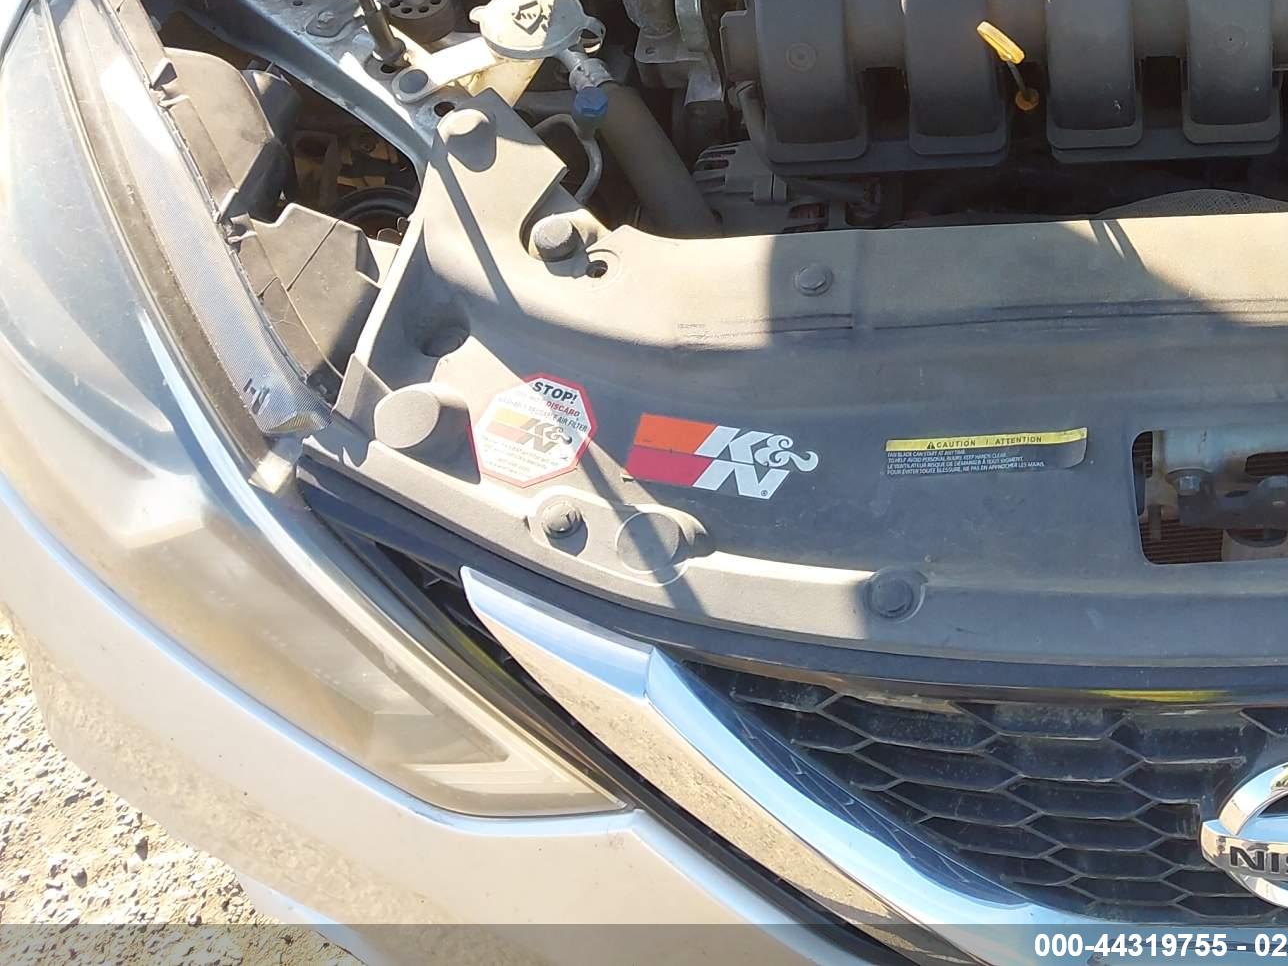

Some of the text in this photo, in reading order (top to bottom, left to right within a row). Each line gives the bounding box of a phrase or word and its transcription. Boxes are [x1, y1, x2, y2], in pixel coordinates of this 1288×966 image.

[532, 381, 578, 405] STOP!
[546, 401, 580, 418] DISCARD
[936, 439, 976, 449] CAUTION
[995, 436, 1042, 445] ATTENTION
